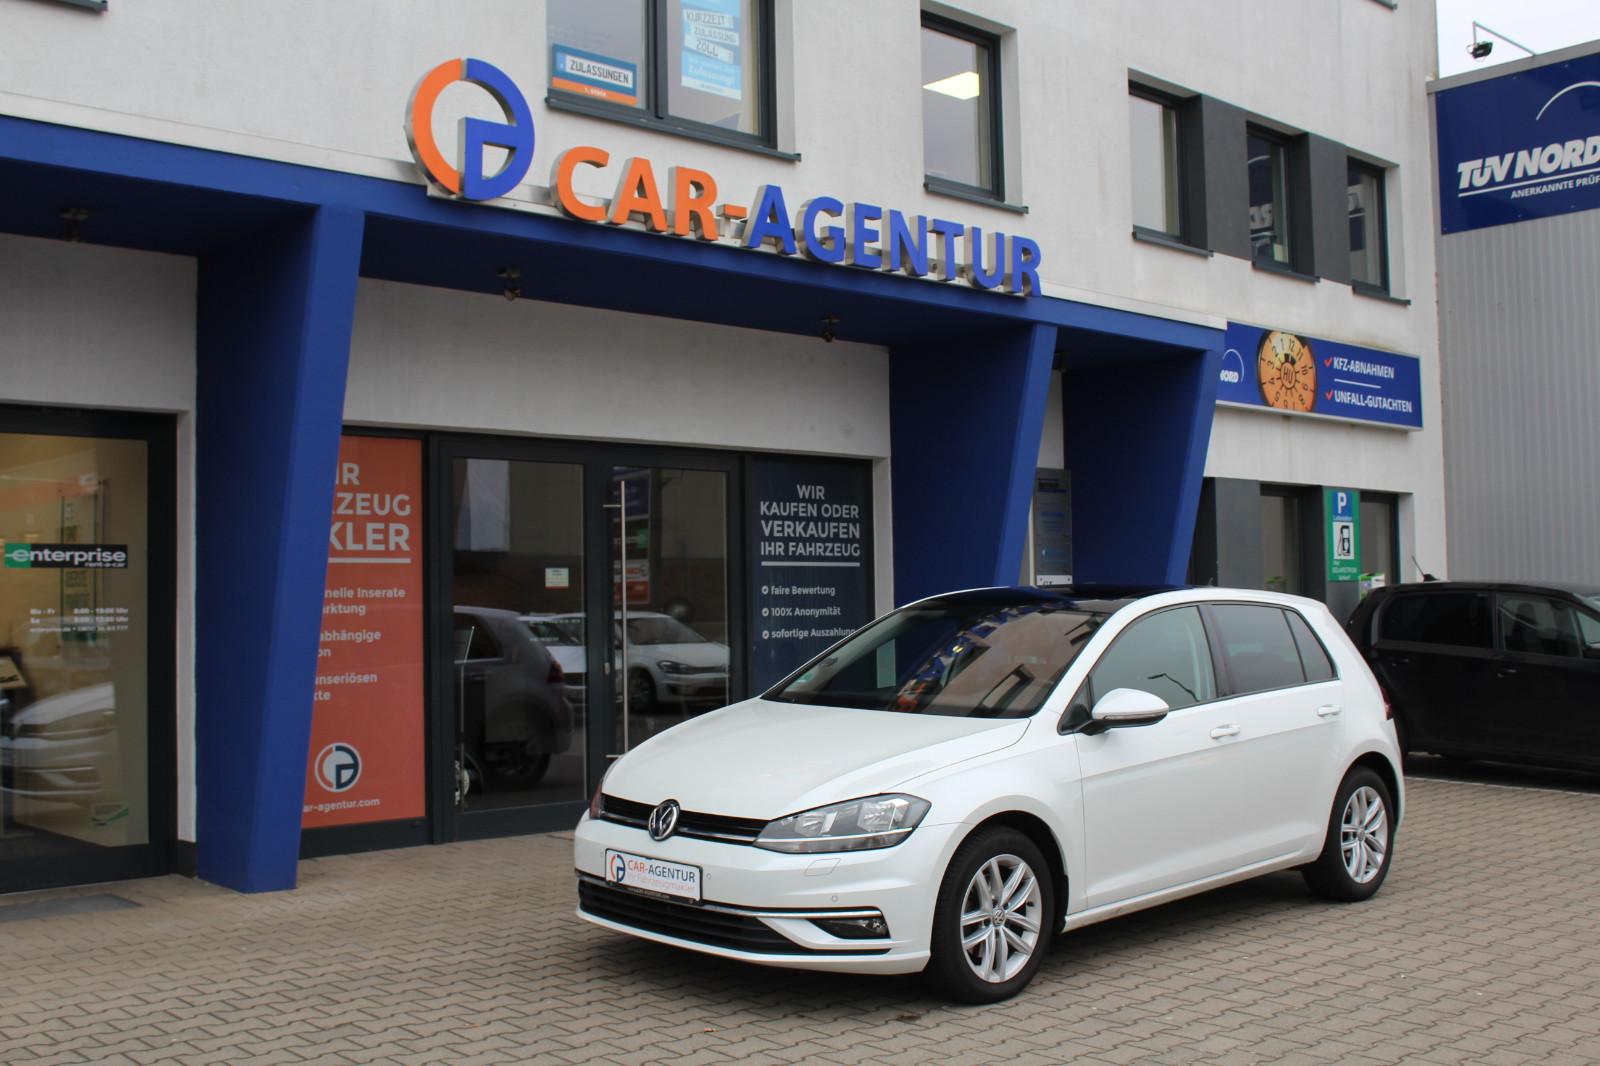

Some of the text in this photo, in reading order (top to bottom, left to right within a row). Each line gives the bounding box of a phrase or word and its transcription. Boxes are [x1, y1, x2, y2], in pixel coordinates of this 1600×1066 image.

[695, 39, 719, 57] ZOLL
[569, 58, 630, 85] ZULASSUNGEN
[1513, 135, 1600, 179] NORD
[1510, 181, 1574, 199] ANERKANNTE
[555, 146, 1043, 298] CAR-AGENTUR
[1333, 357, 1395, 379] KFZ-ABNAHMEN
[1334, 390, 1413, 413] UNFALL-GUTACHTEN
[335, 462, 360, 486] R
[797, 484, 825, 500] WIR
[760, 501, 860, 518] KAUFEN ODER
[1337, 491, 1347, 514] P
[329, 522, 411, 552] KLER
[760, 520, 861, 539] VERKAUFEN
[6, 548, 126, 565] enterprise
[760, 541, 861, 556] IHR FAHRZEUG
[357, 587, 406, 598] Inserate
[771, 585, 836, 597] faire Bewertung
[771, 606, 841, 618] 100% Anonymität
[771, 628, 809, 639] sofortige
[627, 860, 696, 883] CAR-AGENTUR
